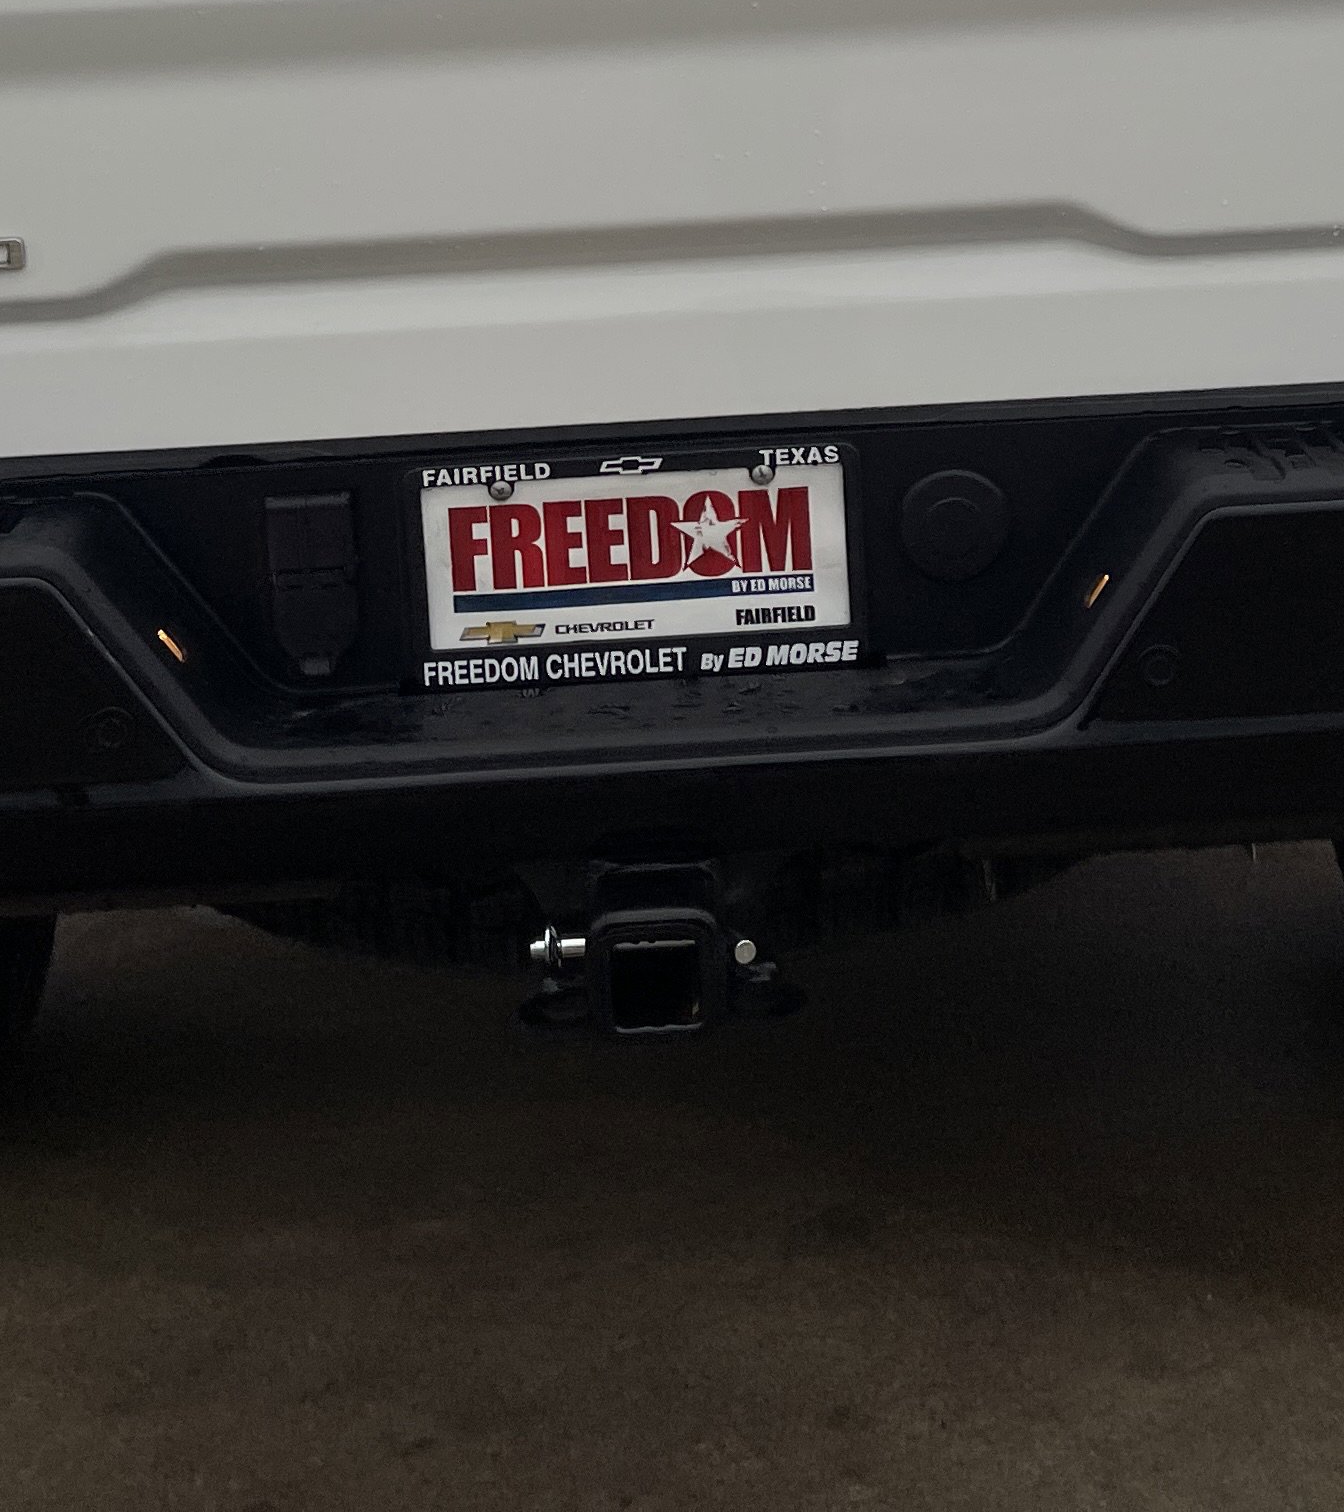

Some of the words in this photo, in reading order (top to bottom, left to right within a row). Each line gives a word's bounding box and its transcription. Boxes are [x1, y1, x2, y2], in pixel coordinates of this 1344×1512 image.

[758, 445, 839, 466] TEXAS
[422, 462, 551, 487] FAIRFIELD
[448, 486, 813, 592] FREEDOM
[732, 579, 748, 593] BY
[750, 579, 766, 592] ED
[768, 576, 812, 591] MORSE
[735, 605, 816, 626] FAIRFIELD
[555, 619, 655, 635] CHEVROLET
[423, 655, 539, 687] FREEDOM
[546, 647, 687, 681] CHEVROLET
[727, 646, 763, 669] ED
[765, 640, 859, 667] MORSE
